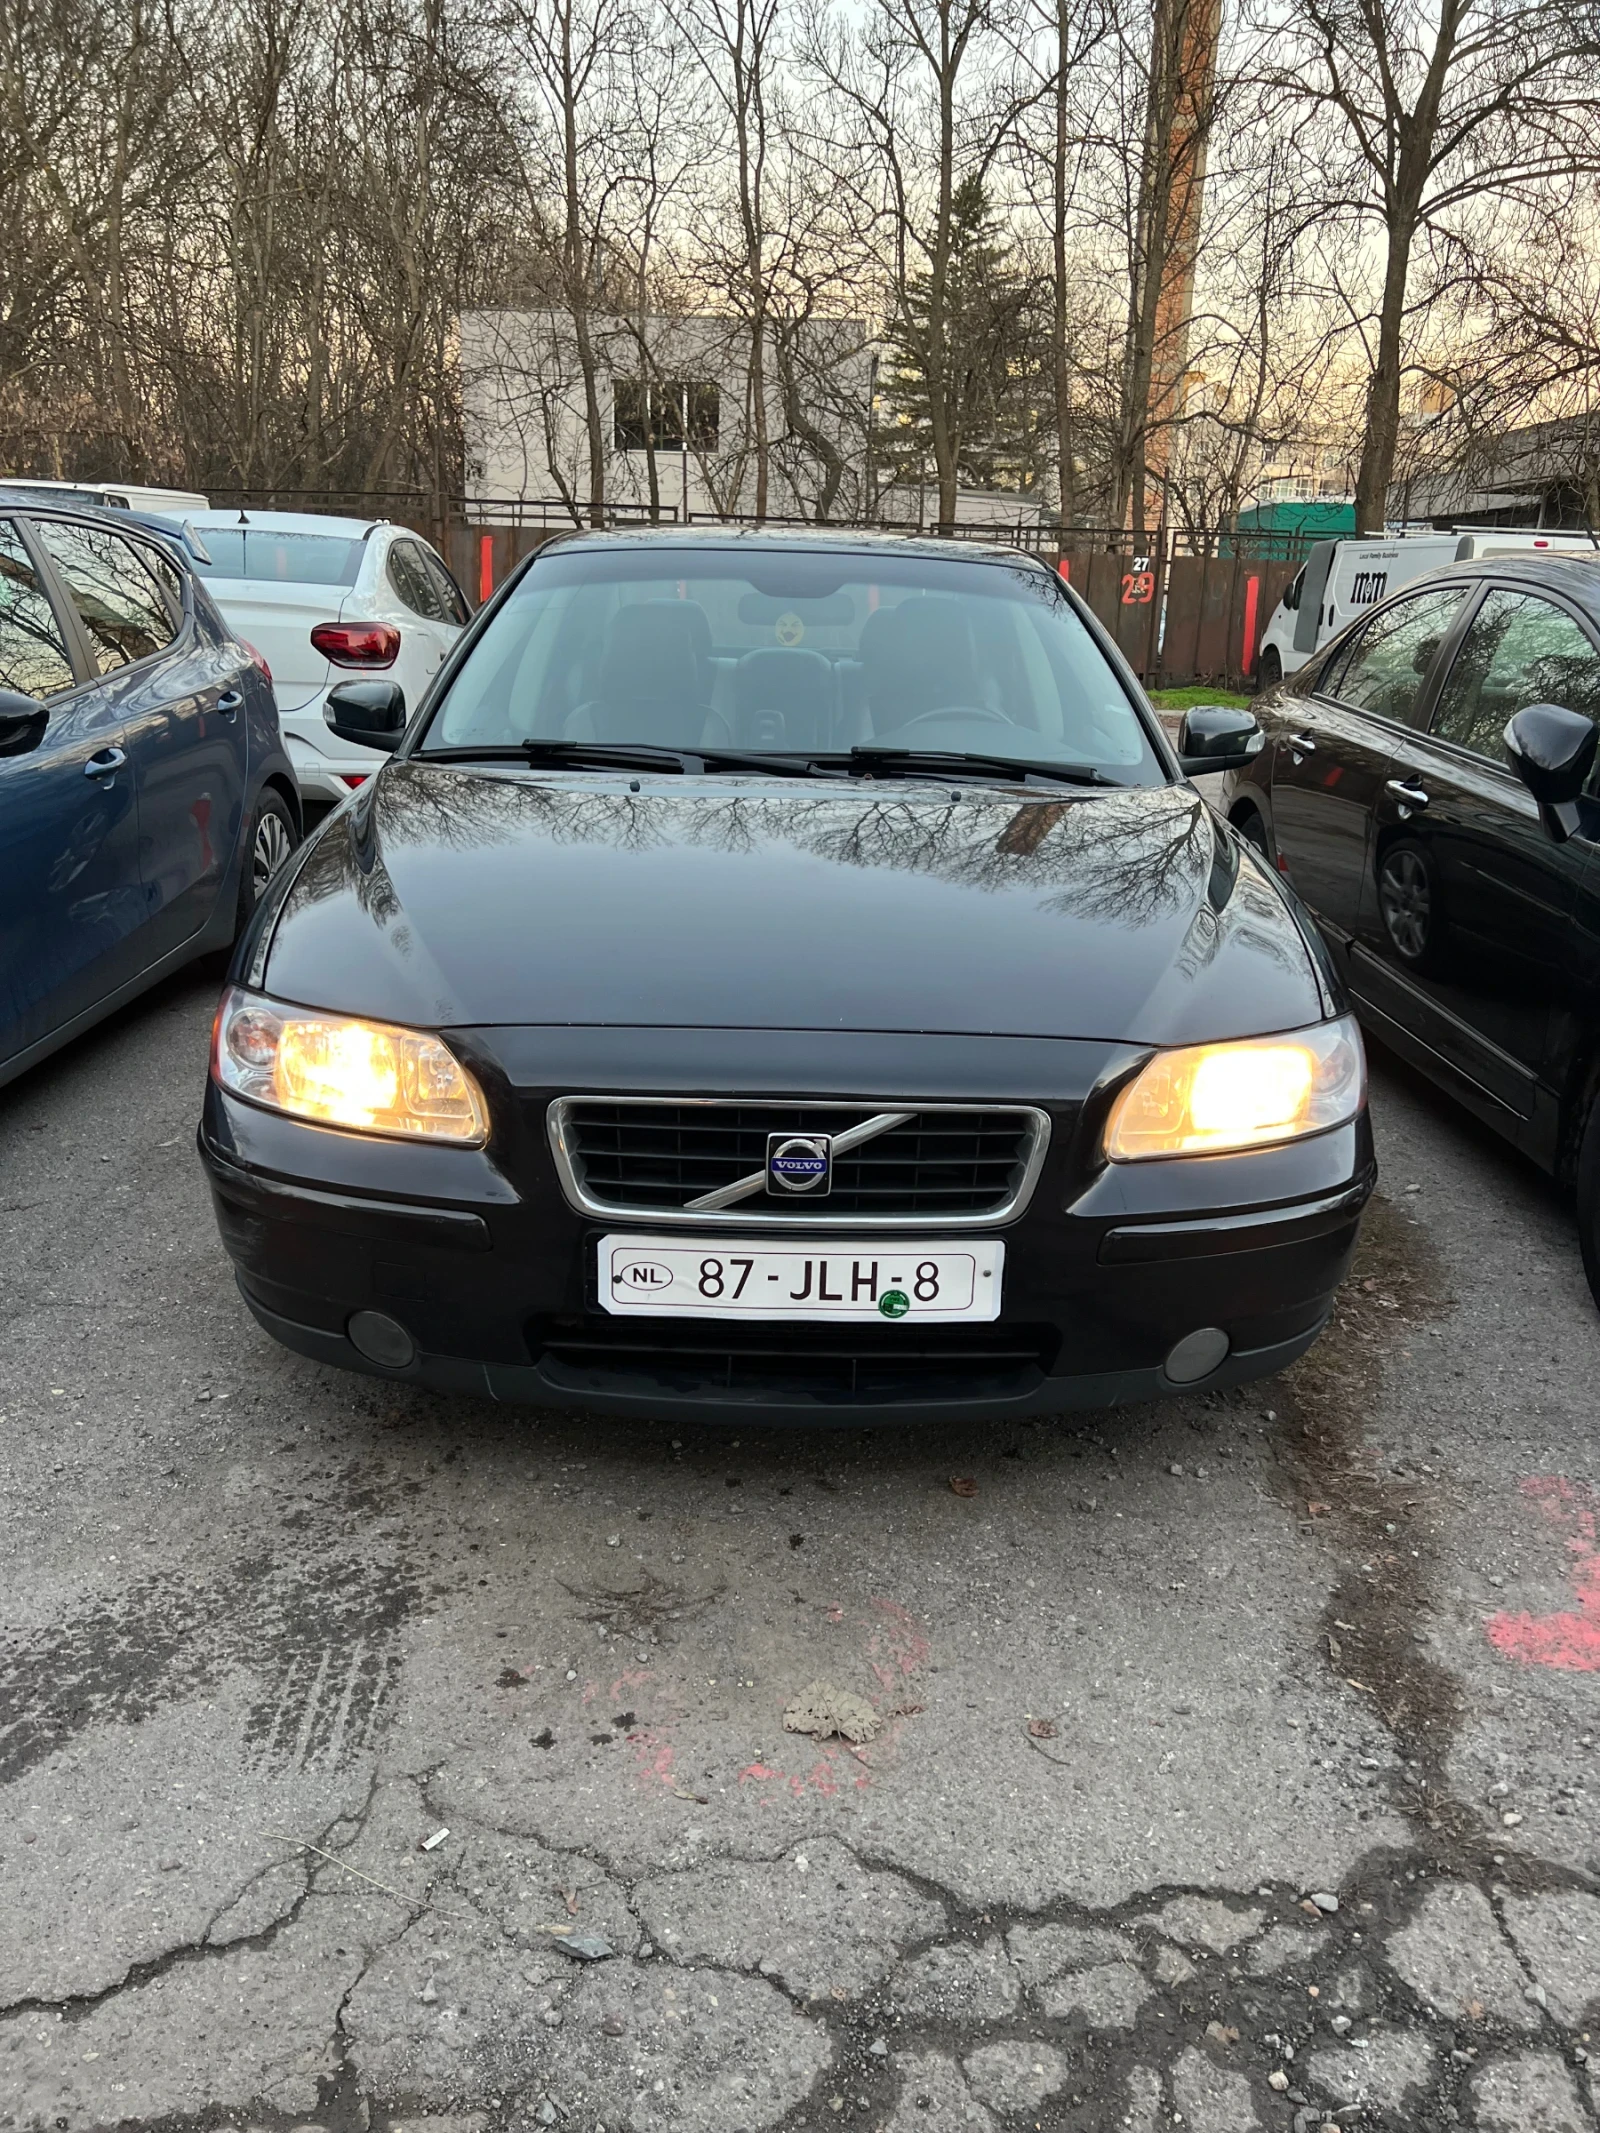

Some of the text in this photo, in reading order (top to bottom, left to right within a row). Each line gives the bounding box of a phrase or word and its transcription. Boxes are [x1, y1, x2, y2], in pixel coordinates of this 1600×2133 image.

[1133, 557, 1149, 571] 27
[1121, 572, 1155, 604] 29
[776, 1161, 822, 1170] VOLVO
[632, 1268, 663, 1283] NL
